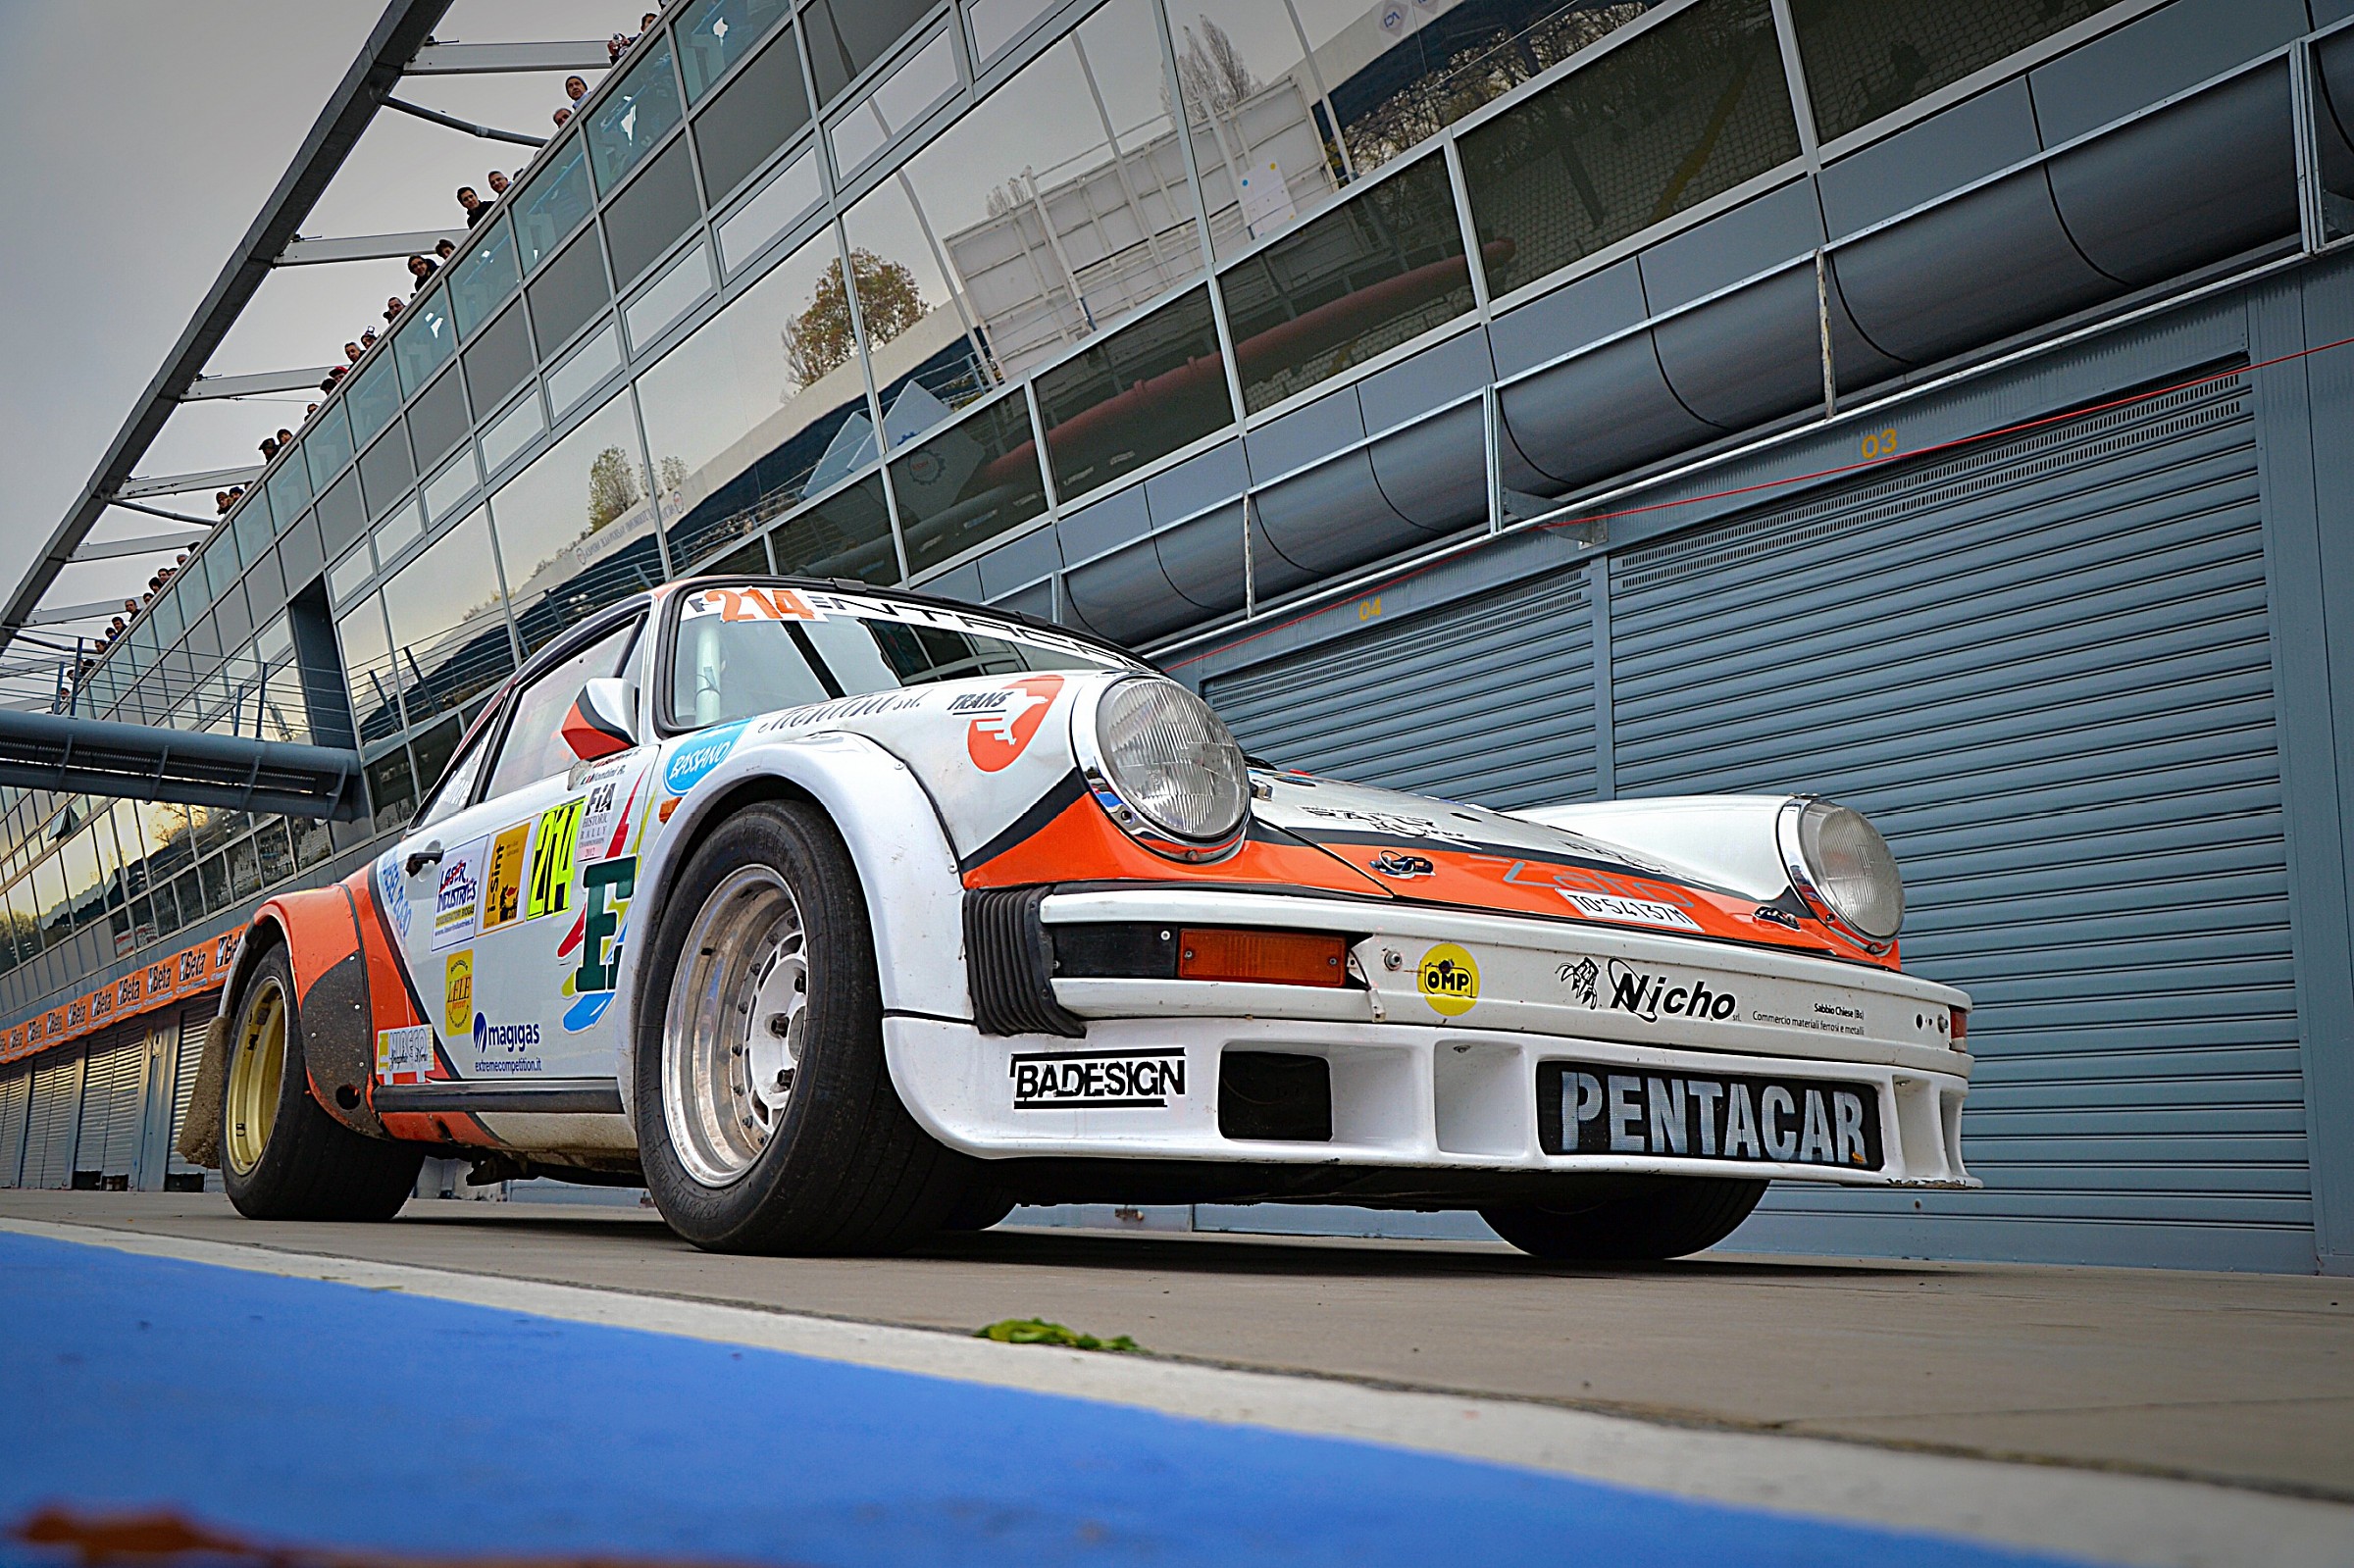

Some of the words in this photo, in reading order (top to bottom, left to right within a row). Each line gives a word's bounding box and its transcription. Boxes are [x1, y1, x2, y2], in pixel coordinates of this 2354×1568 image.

[1861, 428, 1899, 459] 03
[705, 588, 816, 622] 214
[1358, 598, 1382, 622] 04
[947, 691, 1014, 711] TRANS
[669, 740, 731, 781] BASSANO
[581, 826, 607, 840] RALLY
[583, 813, 608, 828] HISTORIC
[529, 800, 585, 917] 214
[486, 843, 504, 914] i-Sint
[153, 964, 172, 993] Beta
[186, 949, 206, 979] Beta
[447, 976, 472, 1003] LELE
[1427, 970, 1470, 991] OMP
[1610, 972, 1736, 1021] Nicho
[1814, 1002, 1835, 1015] Sabbio
[1835, 1006, 1854, 1018] Chiese
[1752, 1010, 1791, 1026] Commercio
[1792, 1016, 1819, 1030] materiali
[1820, 1019, 1840, 1032] ferrosi
[1845, 1024, 1865, 1036] metalli
[487, 1023, 539, 1053] magigas
[475, 1057, 542, 1075] extremecompetition.it
[1015, 1059, 1186, 1098] BADESIGN
[1561, 1071, 1868, 1165] PENTACAR
